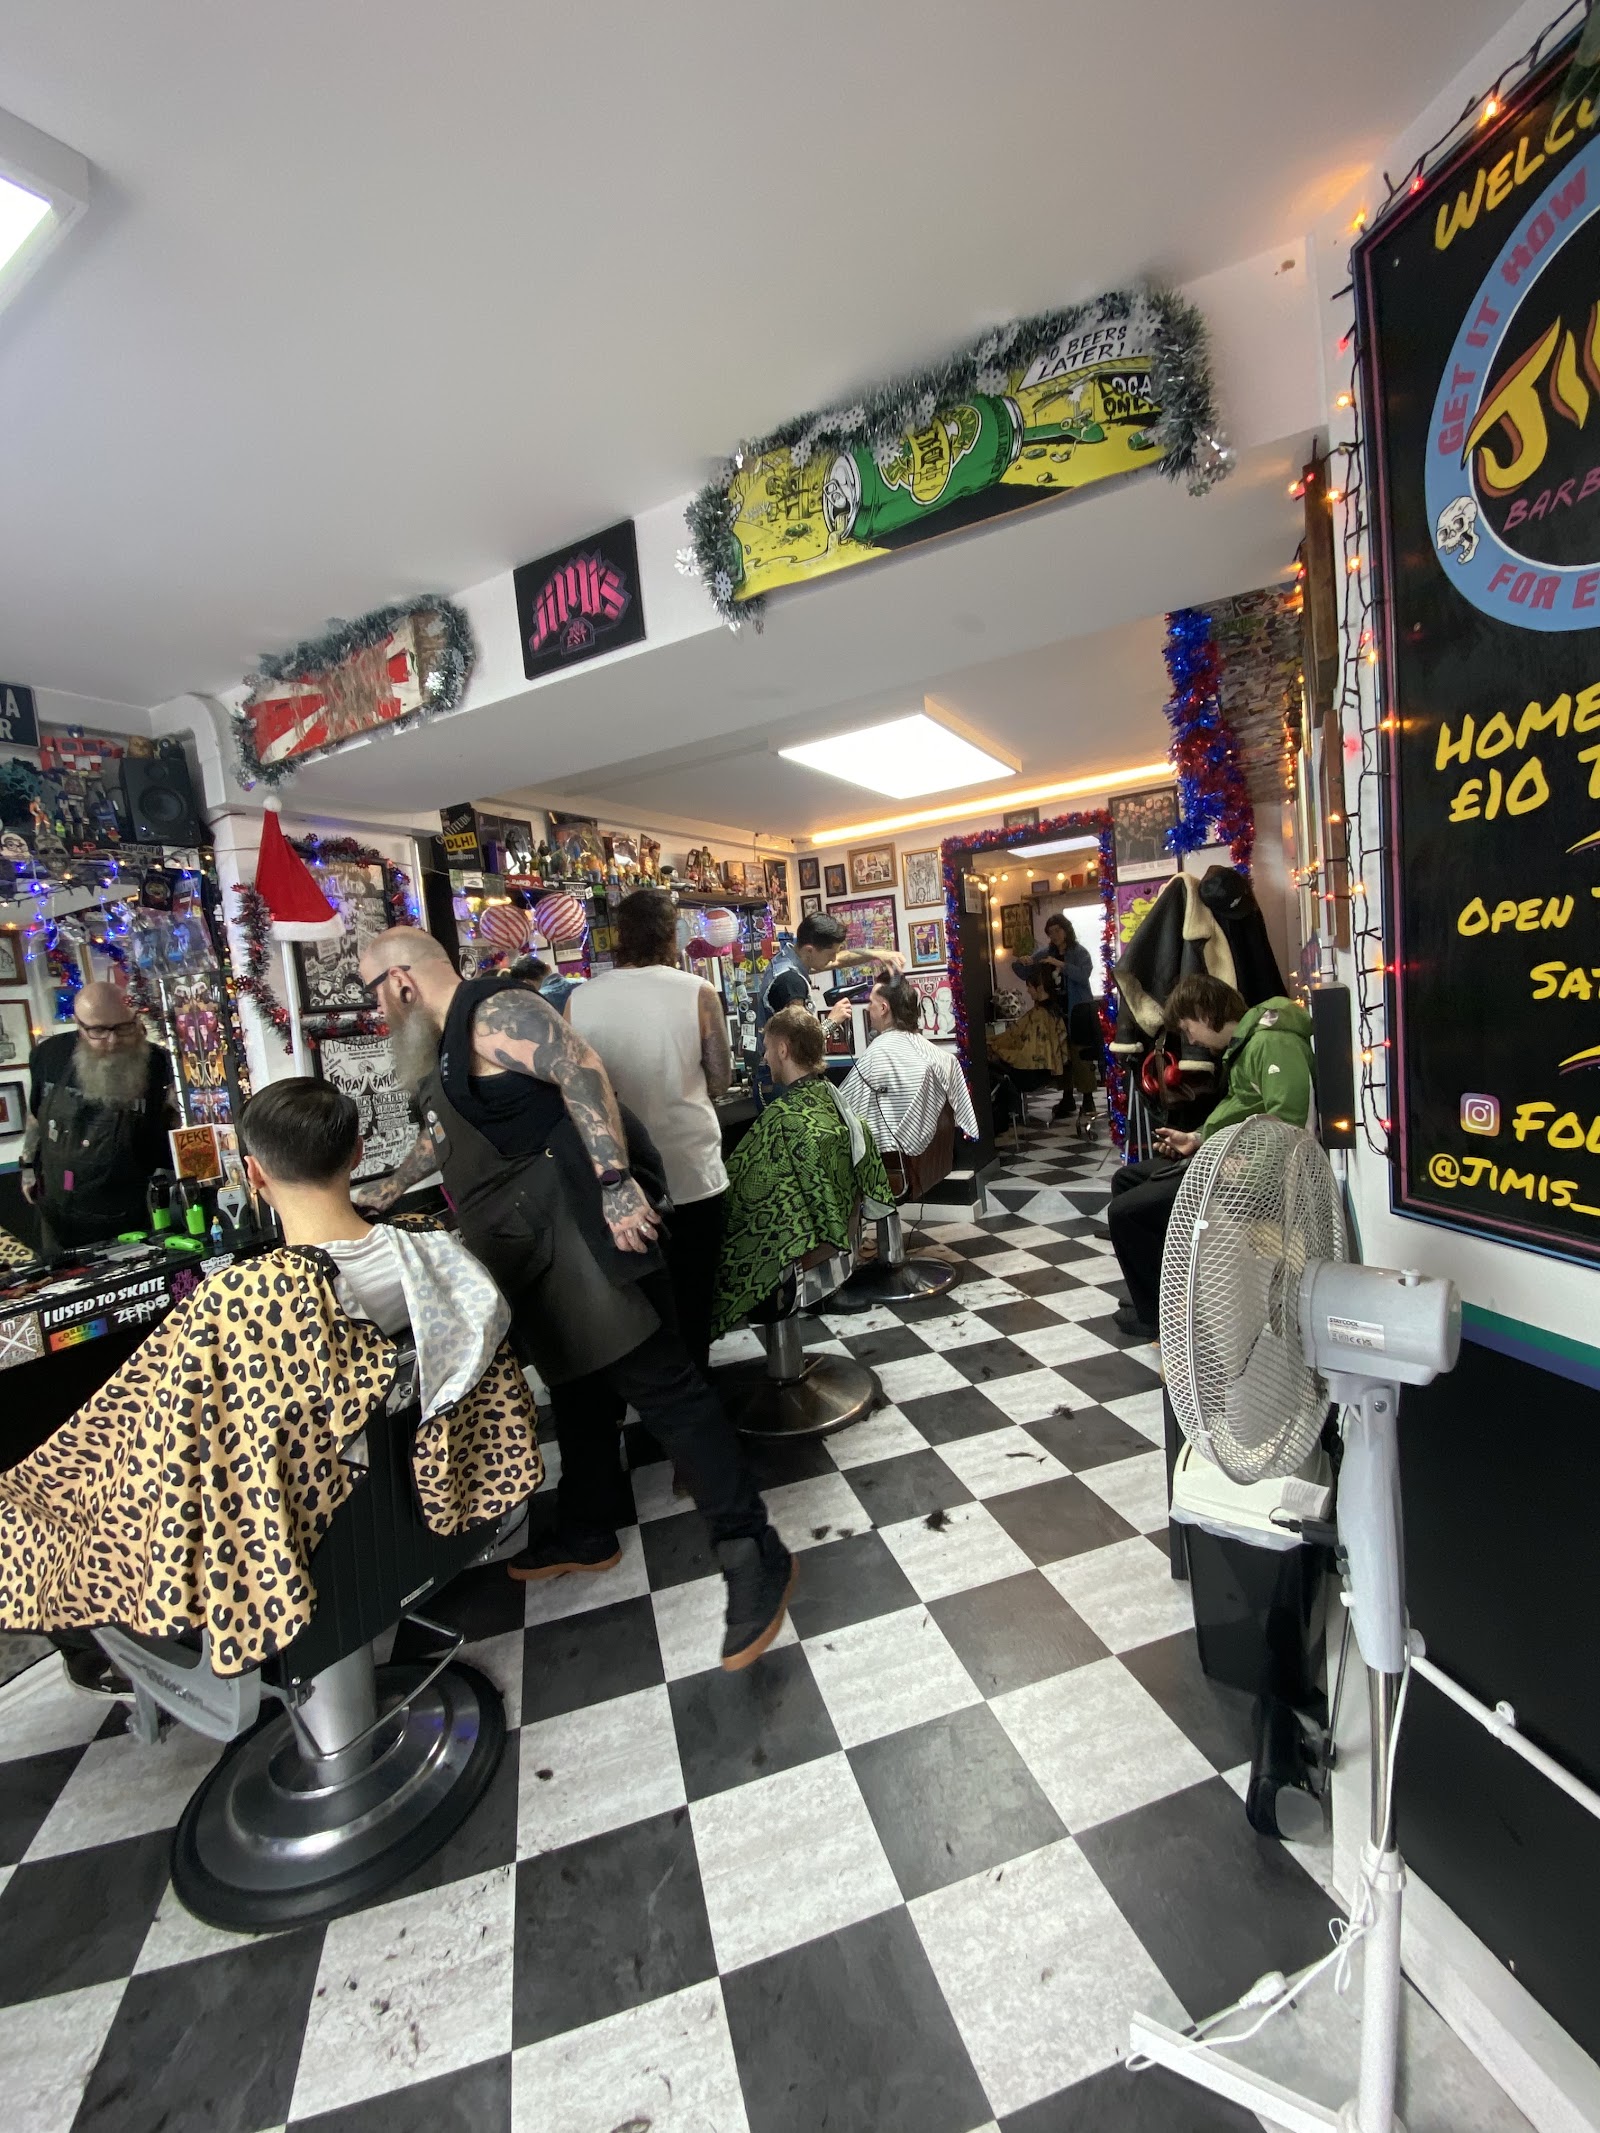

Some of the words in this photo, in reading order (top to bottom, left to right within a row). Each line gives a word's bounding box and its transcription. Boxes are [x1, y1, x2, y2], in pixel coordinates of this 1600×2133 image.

[1438, 364, 1476, 456] GET
[1465, 296, 1500, 348] IT
[1501, 165, 1588, 285] HOW
[1067, 325, 1128, 356] BEERS
[1488, 563, 1562, 610] FOR
[0, 687, 21, 719] A
[1448, 755, 1550, 823] £10
[446, 835, 475, 850] DLH!
[1457, 896, 1575, 938] OPEN
[329, 1069, 365, 1094] FRIDAY
[179, 1129, 211, 1151] ZEKE
[43, 1310, 51, 1328] I
[51, 1298, 96, 1323] USED
[96, 1291, 117, 1307] TO
[117, 1275, 166, 1301] SKATE
[113, 1299, 156, 1324] ZERO
